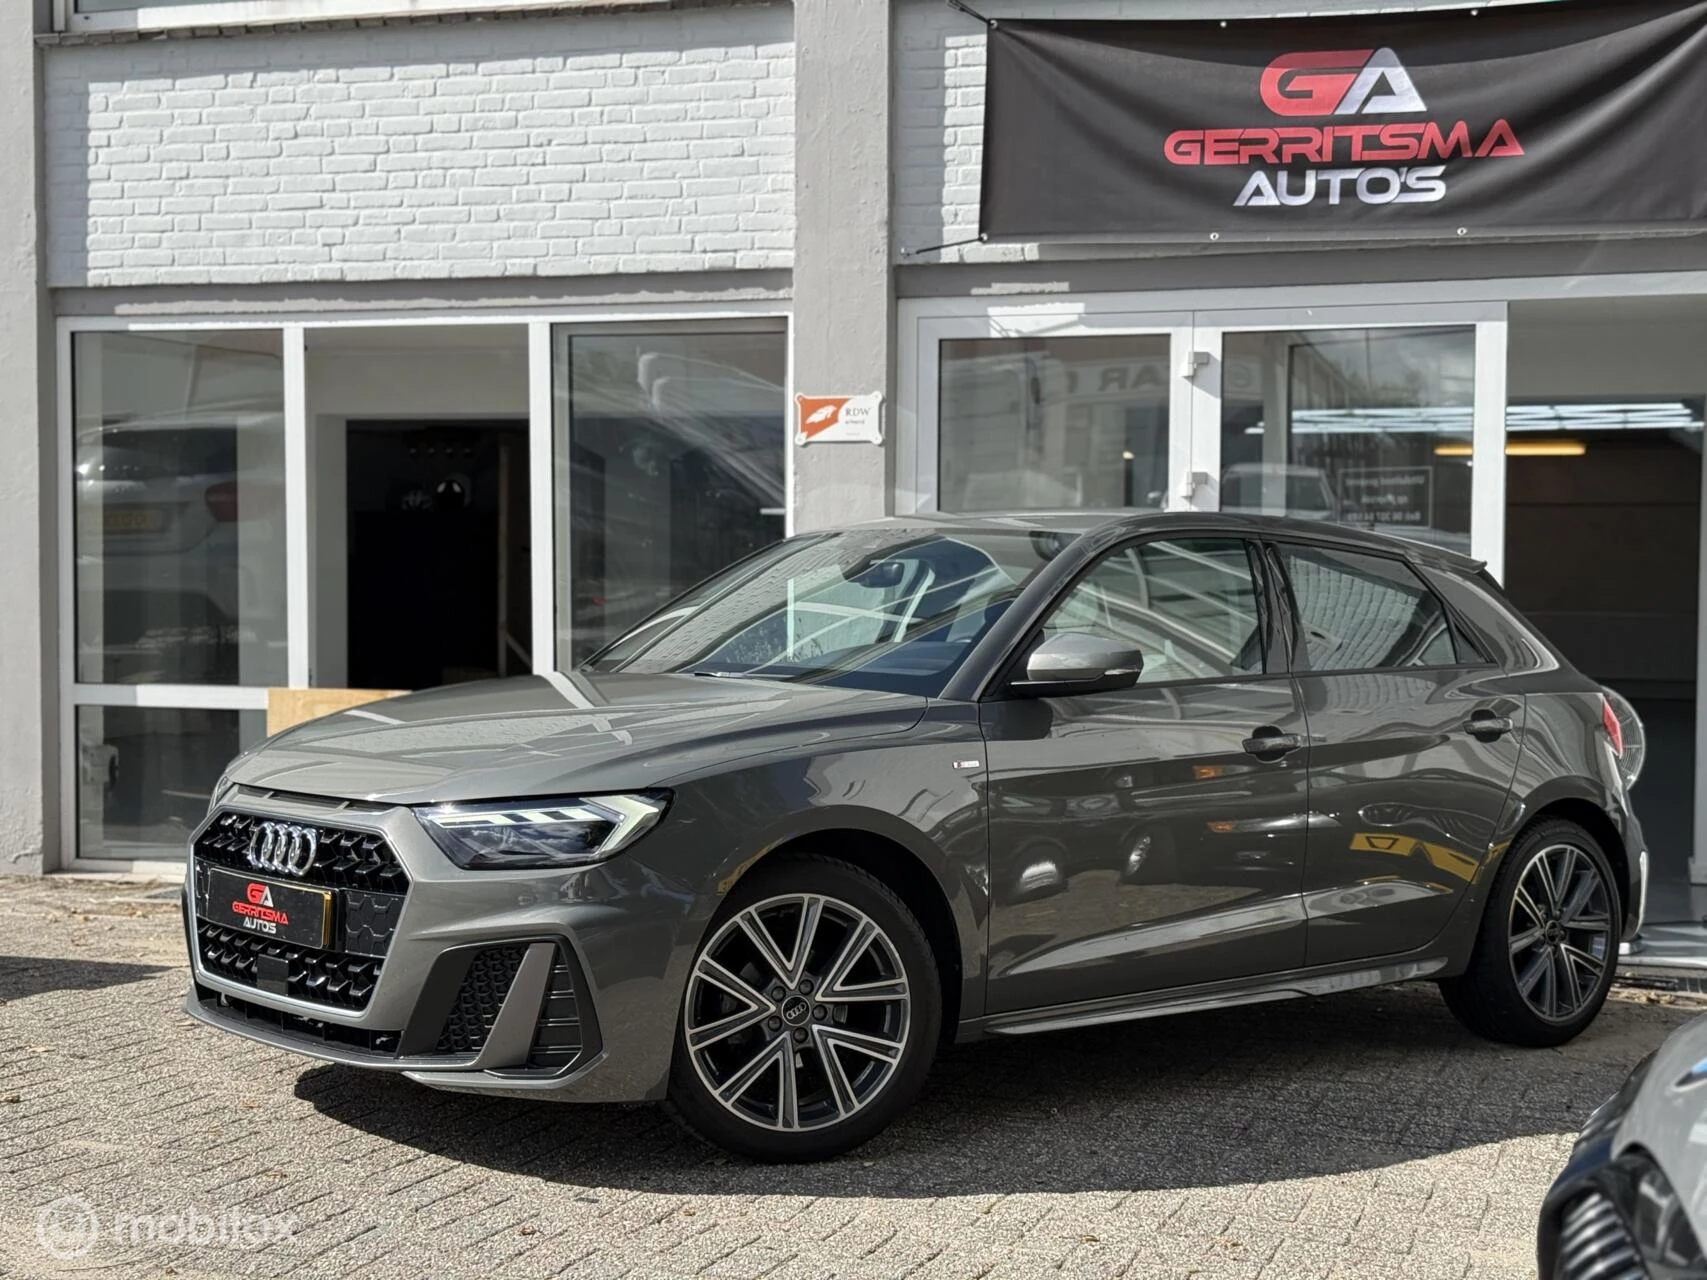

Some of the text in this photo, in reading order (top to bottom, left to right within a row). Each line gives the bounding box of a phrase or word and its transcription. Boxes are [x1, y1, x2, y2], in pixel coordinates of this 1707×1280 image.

[1259, 47, 1427, 116] GA
[1164, 119, 1525, 165] GERRITSMA
[1233, 165, 1446, 206] AUTO'S
[845, 407, 871, 417] RDW
[247, 883, 274, 908] GA
[232, 901, 289, 926] GERRITSMA
